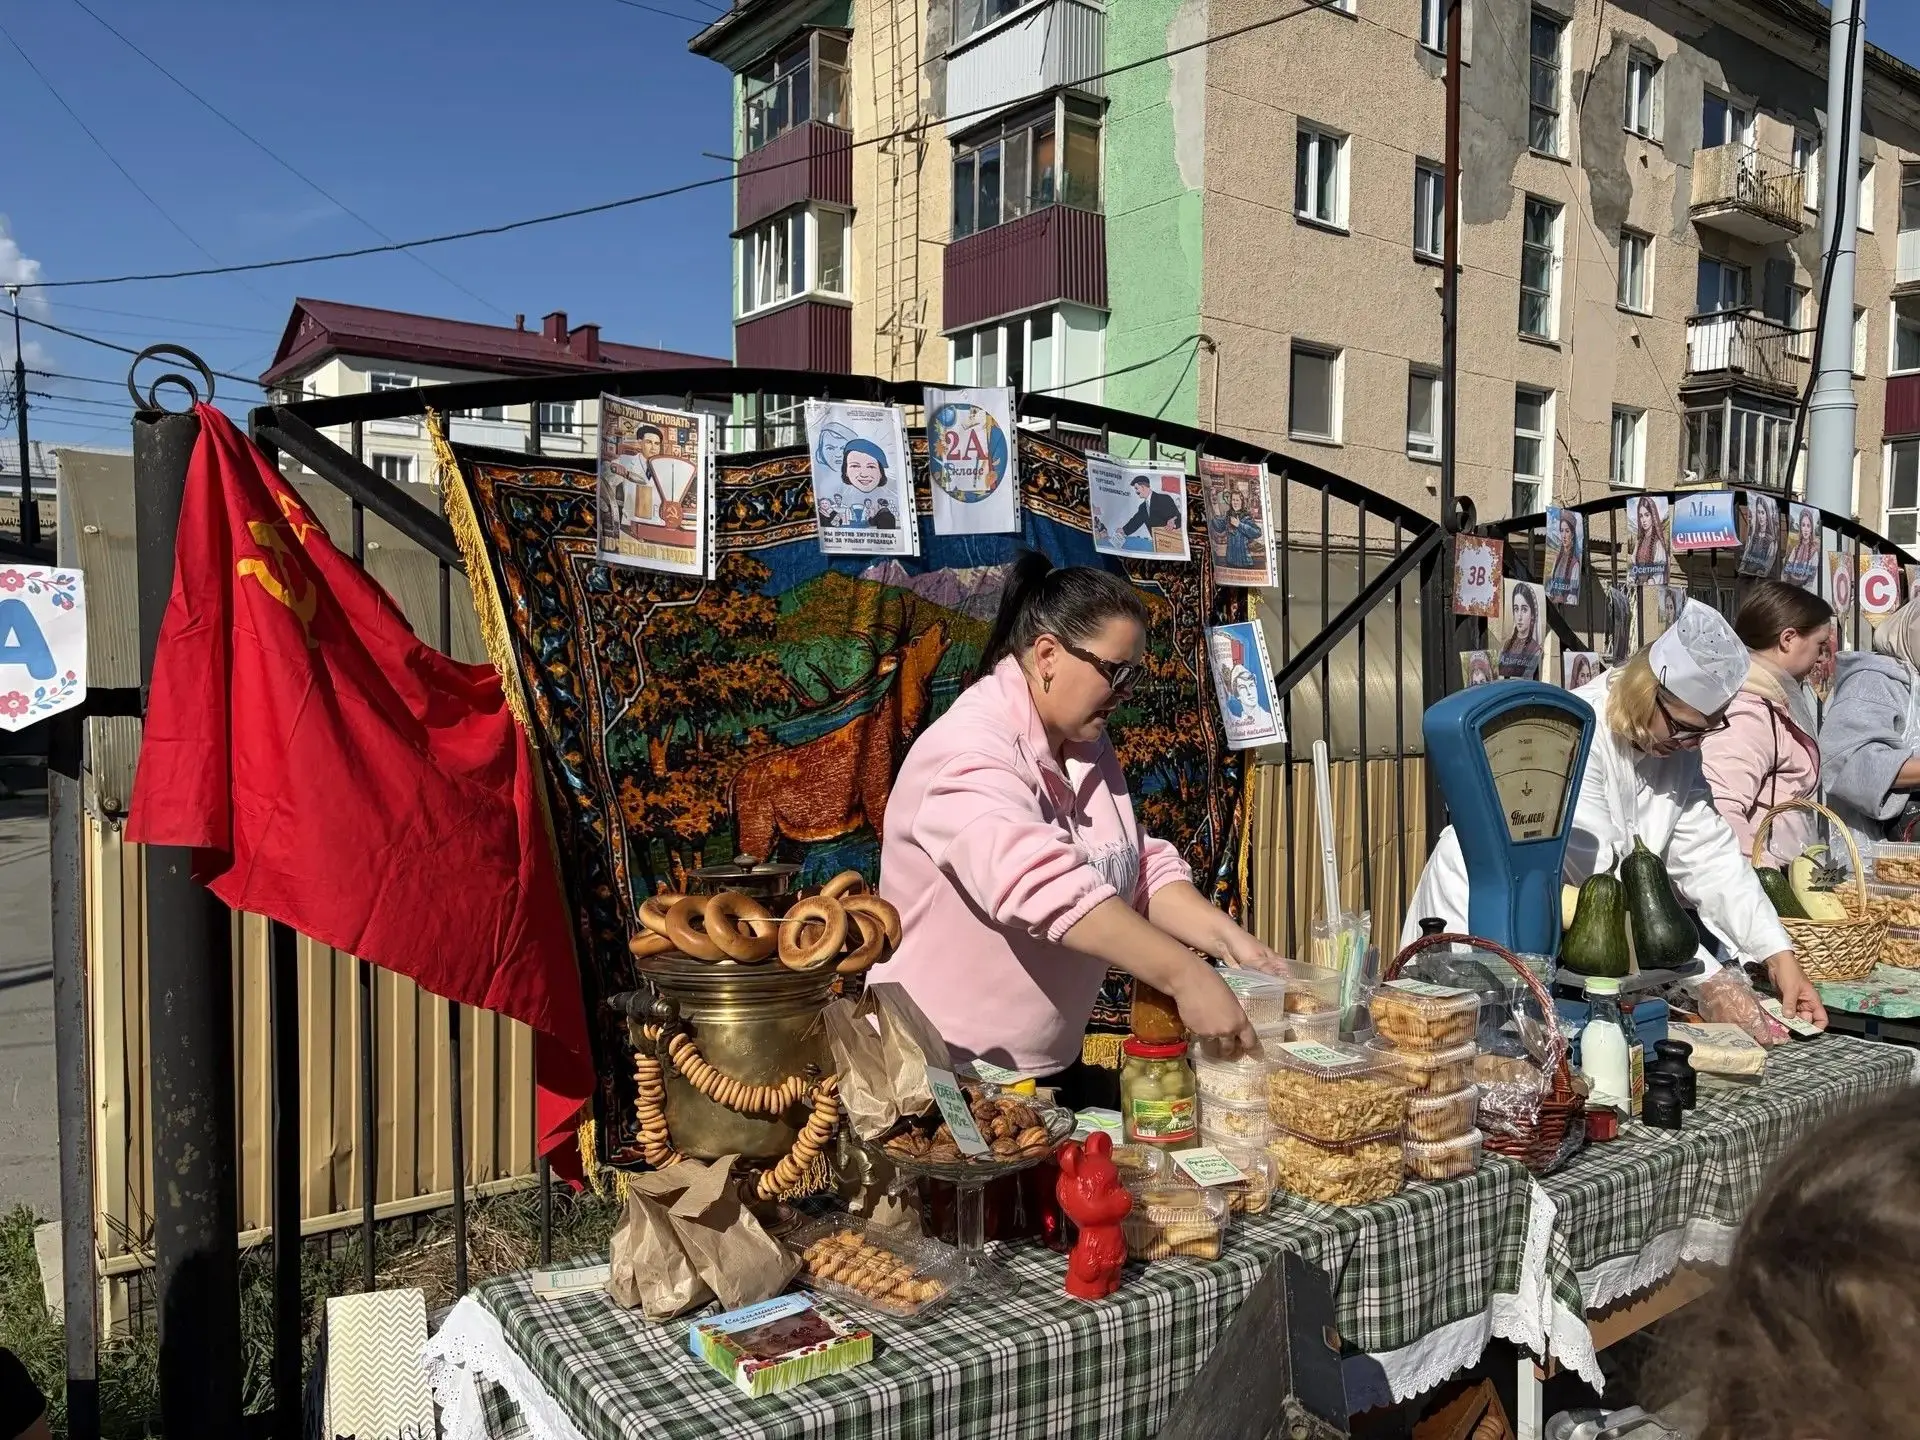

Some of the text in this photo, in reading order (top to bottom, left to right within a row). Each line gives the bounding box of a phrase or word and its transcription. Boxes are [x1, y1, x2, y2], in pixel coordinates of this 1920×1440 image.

[605, 400, 644, 420] КУЛЬТУРНО
[646, 412, 690, 428] ТОРГОВАТЬ
[945, 429, 989, 460] 2А
[1690, 501, 1716, 517] Мы
[1677, 526, 1731, 545] едины!
[1467, 565, 1486, 586] 3В
[1632, 565, 1665, 574] Осетины
[1865, 575, 1891, 606] С
